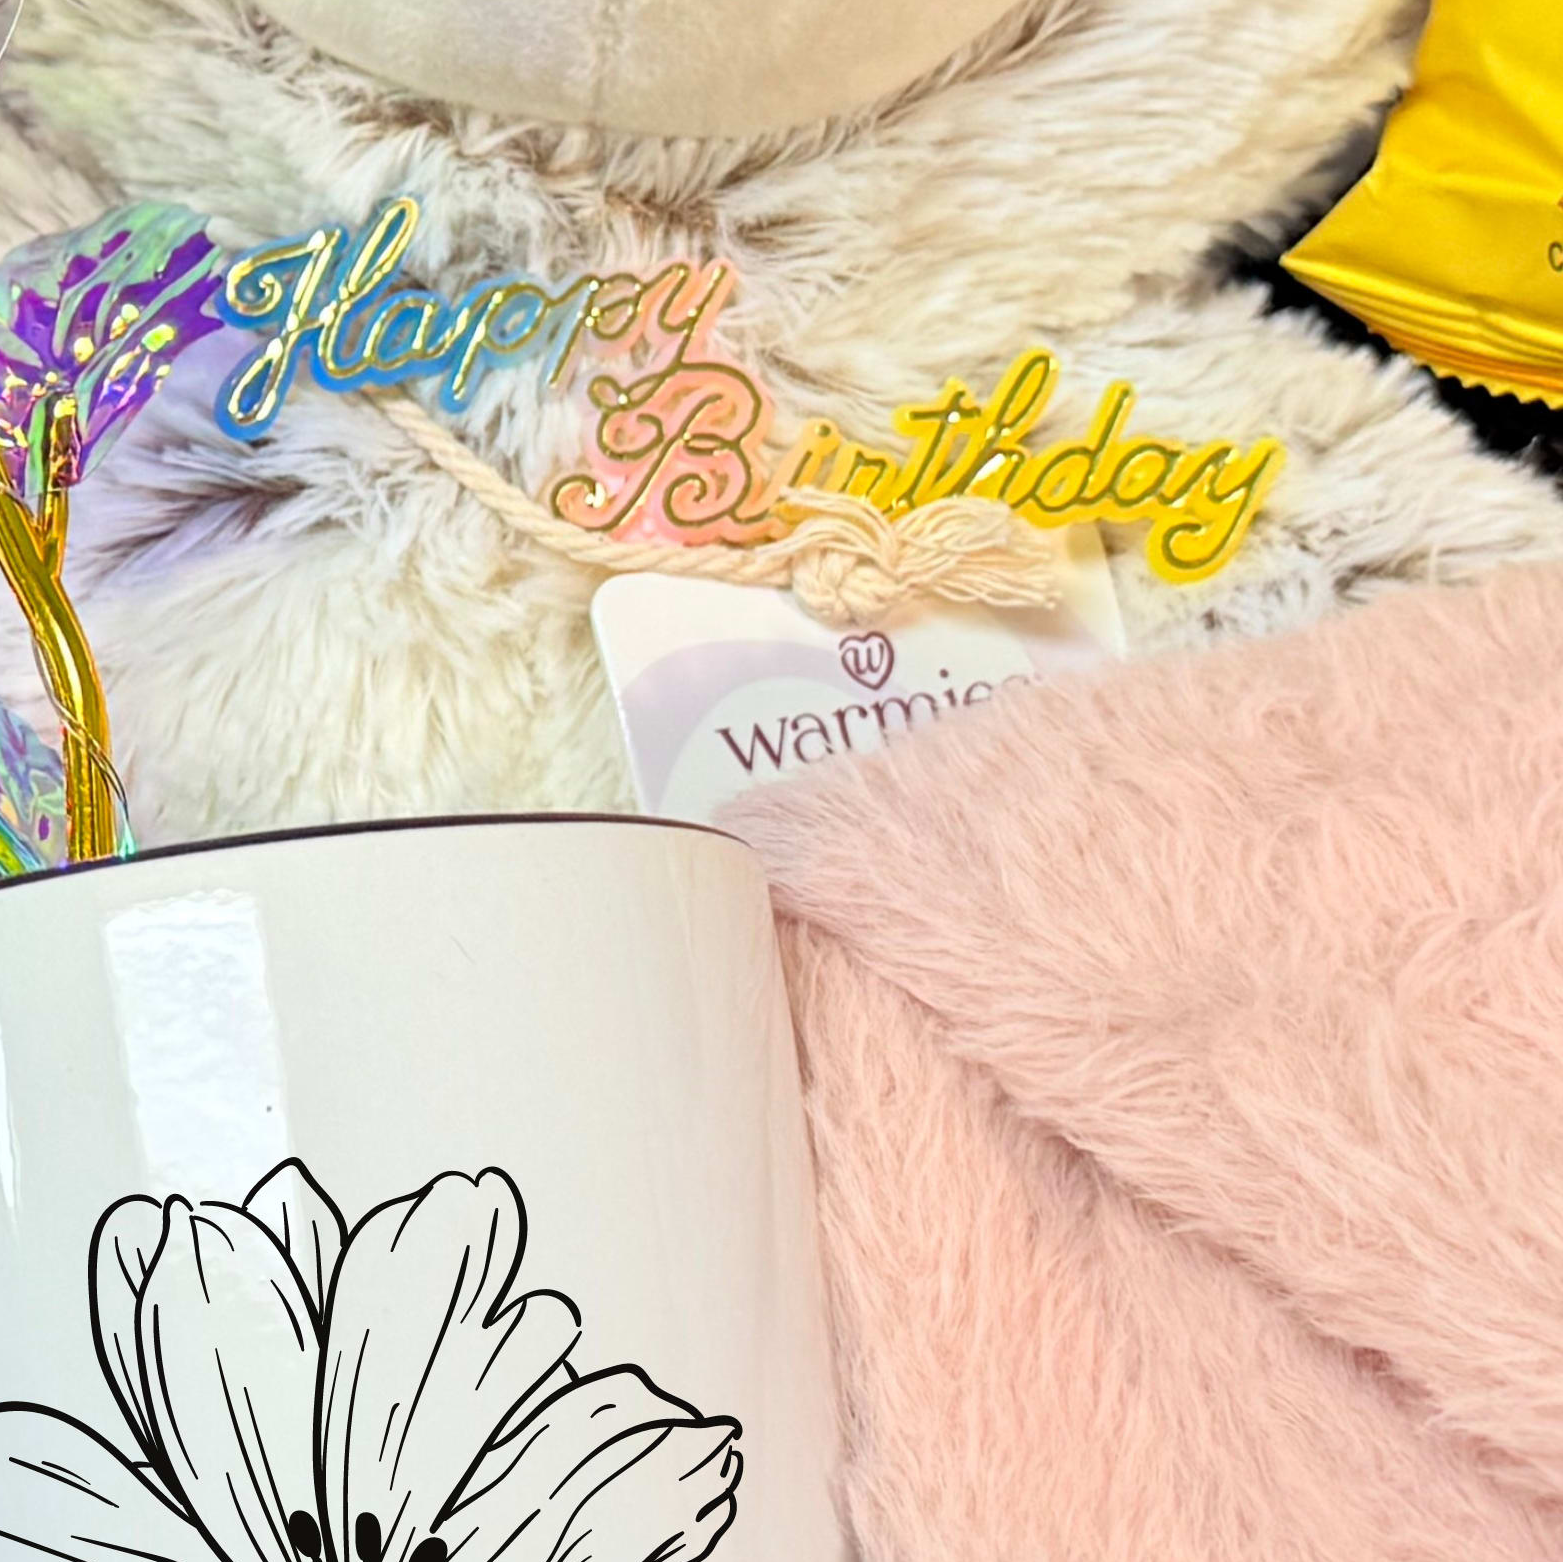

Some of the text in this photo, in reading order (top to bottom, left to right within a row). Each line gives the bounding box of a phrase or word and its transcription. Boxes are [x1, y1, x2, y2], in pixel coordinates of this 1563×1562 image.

[214, 194, 737, 438] Happy
[549, 345, 1284, 583] Birthday
[715, 668, 1035, 776] warmie
